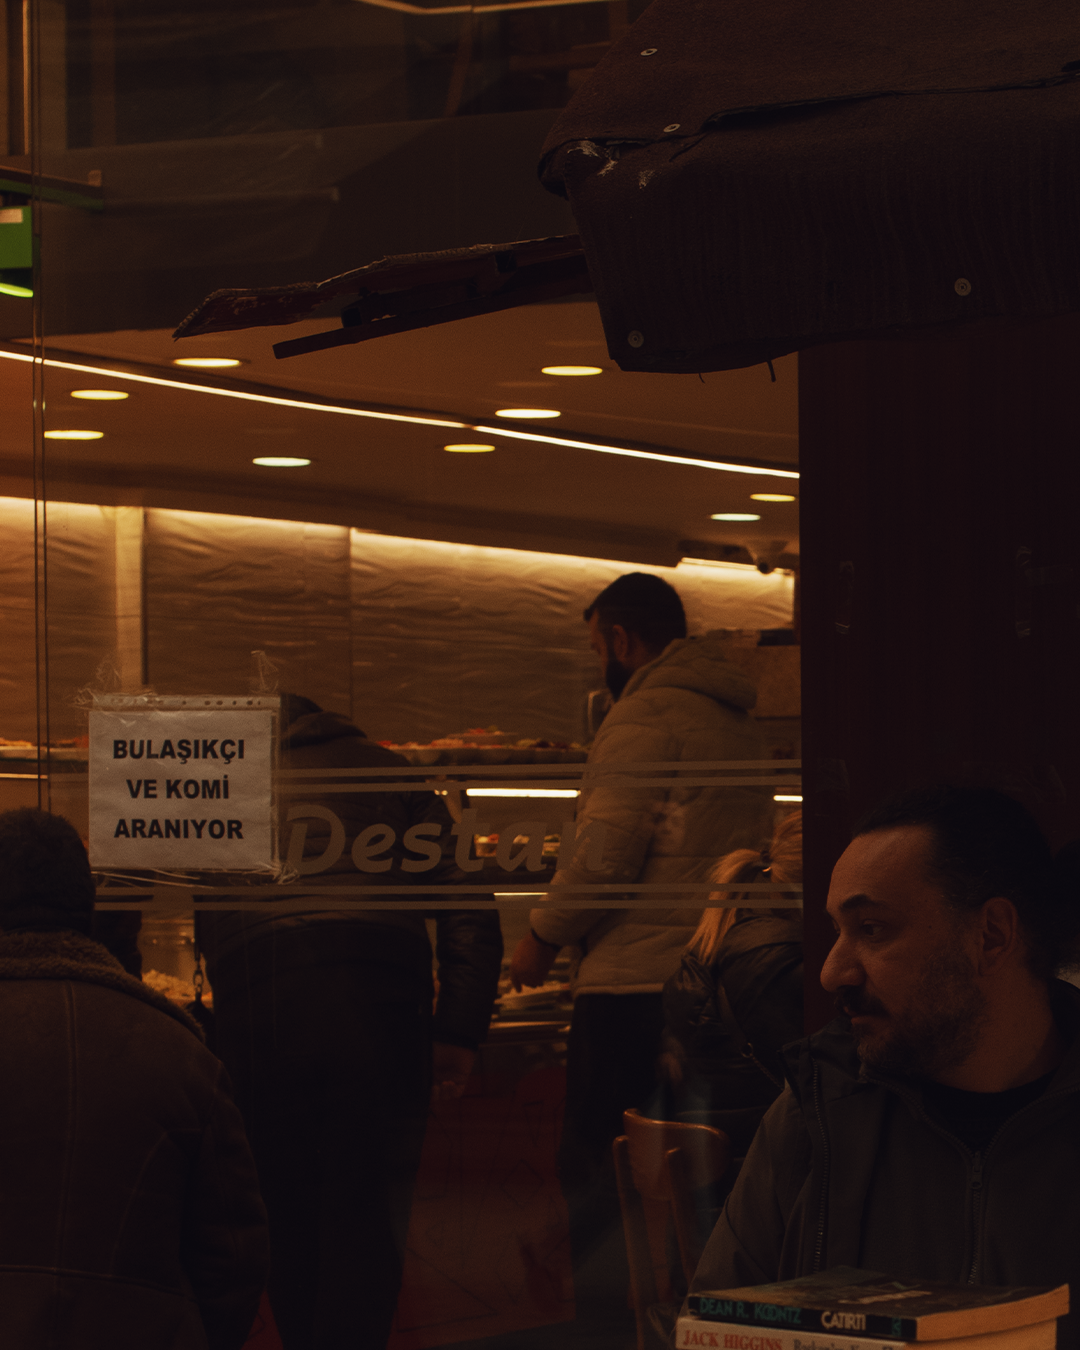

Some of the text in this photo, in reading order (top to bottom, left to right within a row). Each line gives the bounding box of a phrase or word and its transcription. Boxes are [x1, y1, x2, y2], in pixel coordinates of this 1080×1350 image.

[112, 737, 245, 764] BULAŞIKÇI
[126, 774, 230, 800] VE KOMİ
[113, 818, 244, 840] ARANIYOR
[286, 804, 608, 876] Destan
[700, 1296, 733, 1315] DEAN
[754, 1303, 802, 1324] KOONTZ
[683, 1330, 719, 1348] JACK
